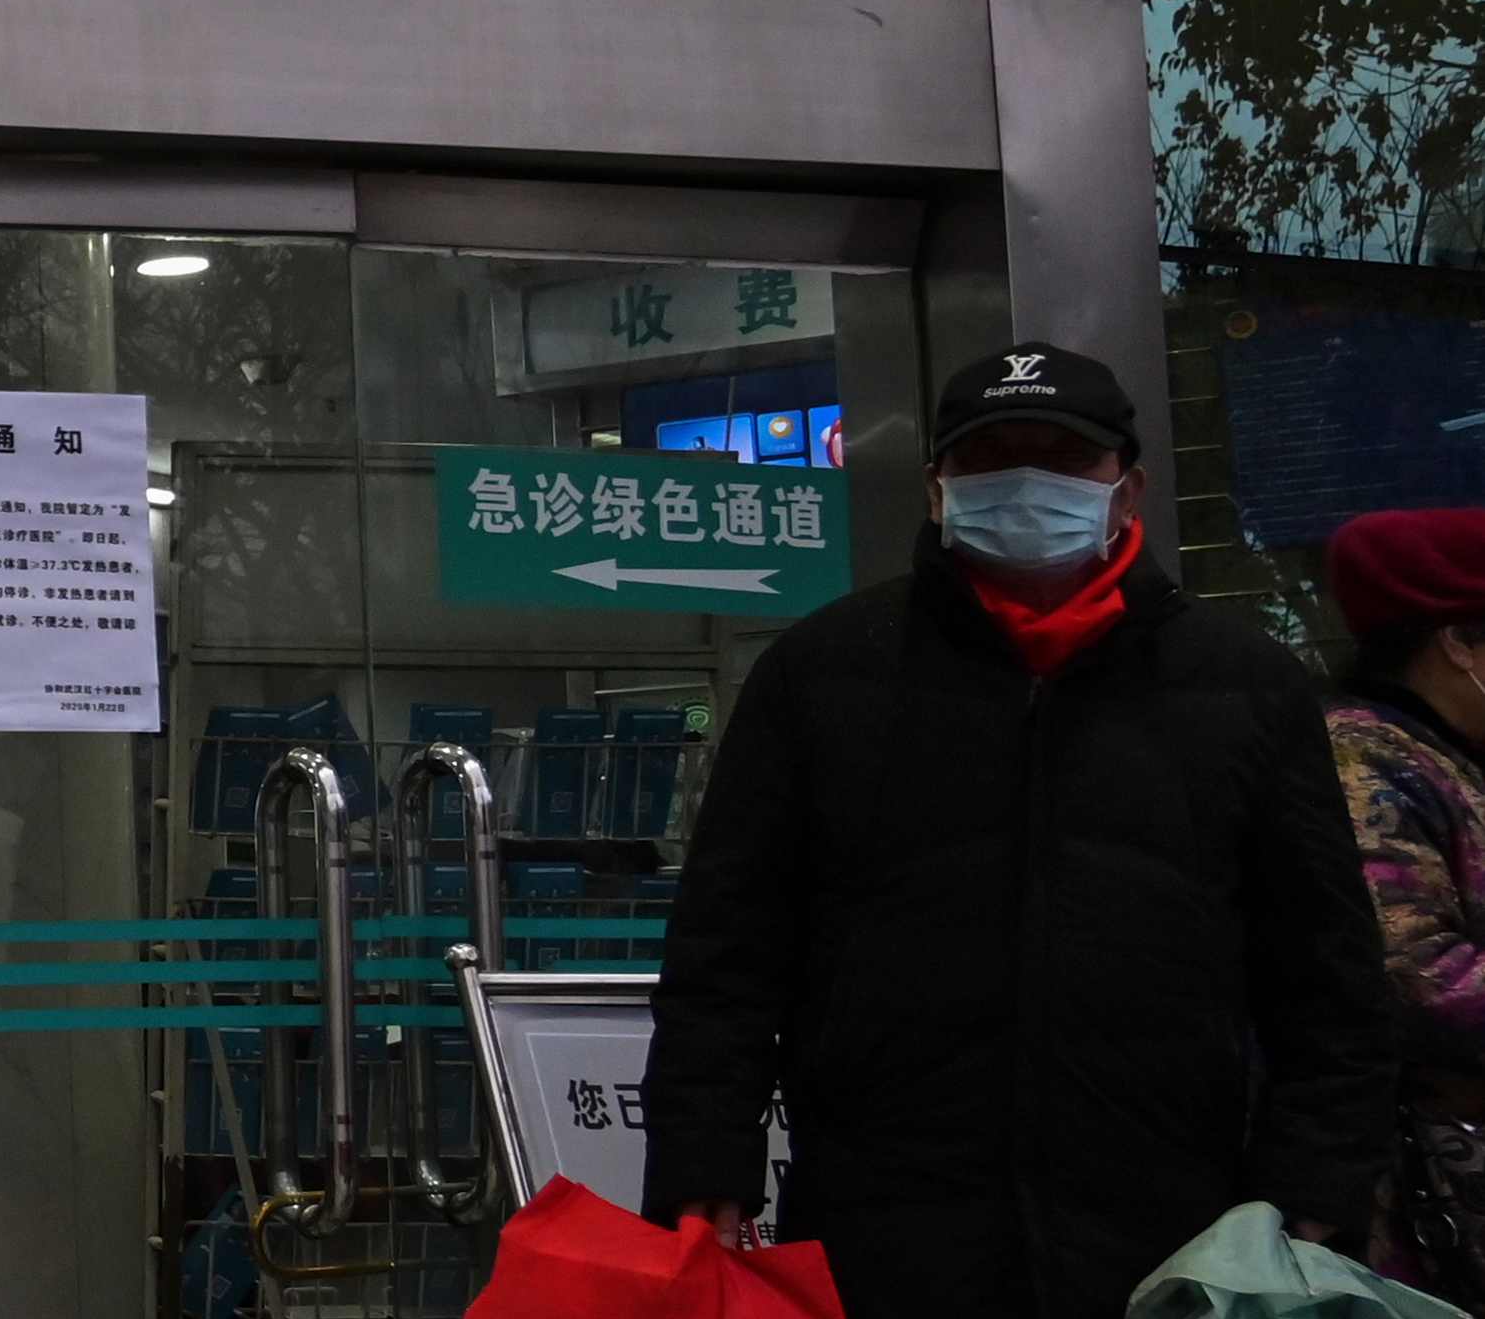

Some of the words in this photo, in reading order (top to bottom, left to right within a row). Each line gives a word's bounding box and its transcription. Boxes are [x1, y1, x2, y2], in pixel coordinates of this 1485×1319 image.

[610, 270, 798, 349] 收费
[468, 468, 825, 549] 急诊绿色通道
